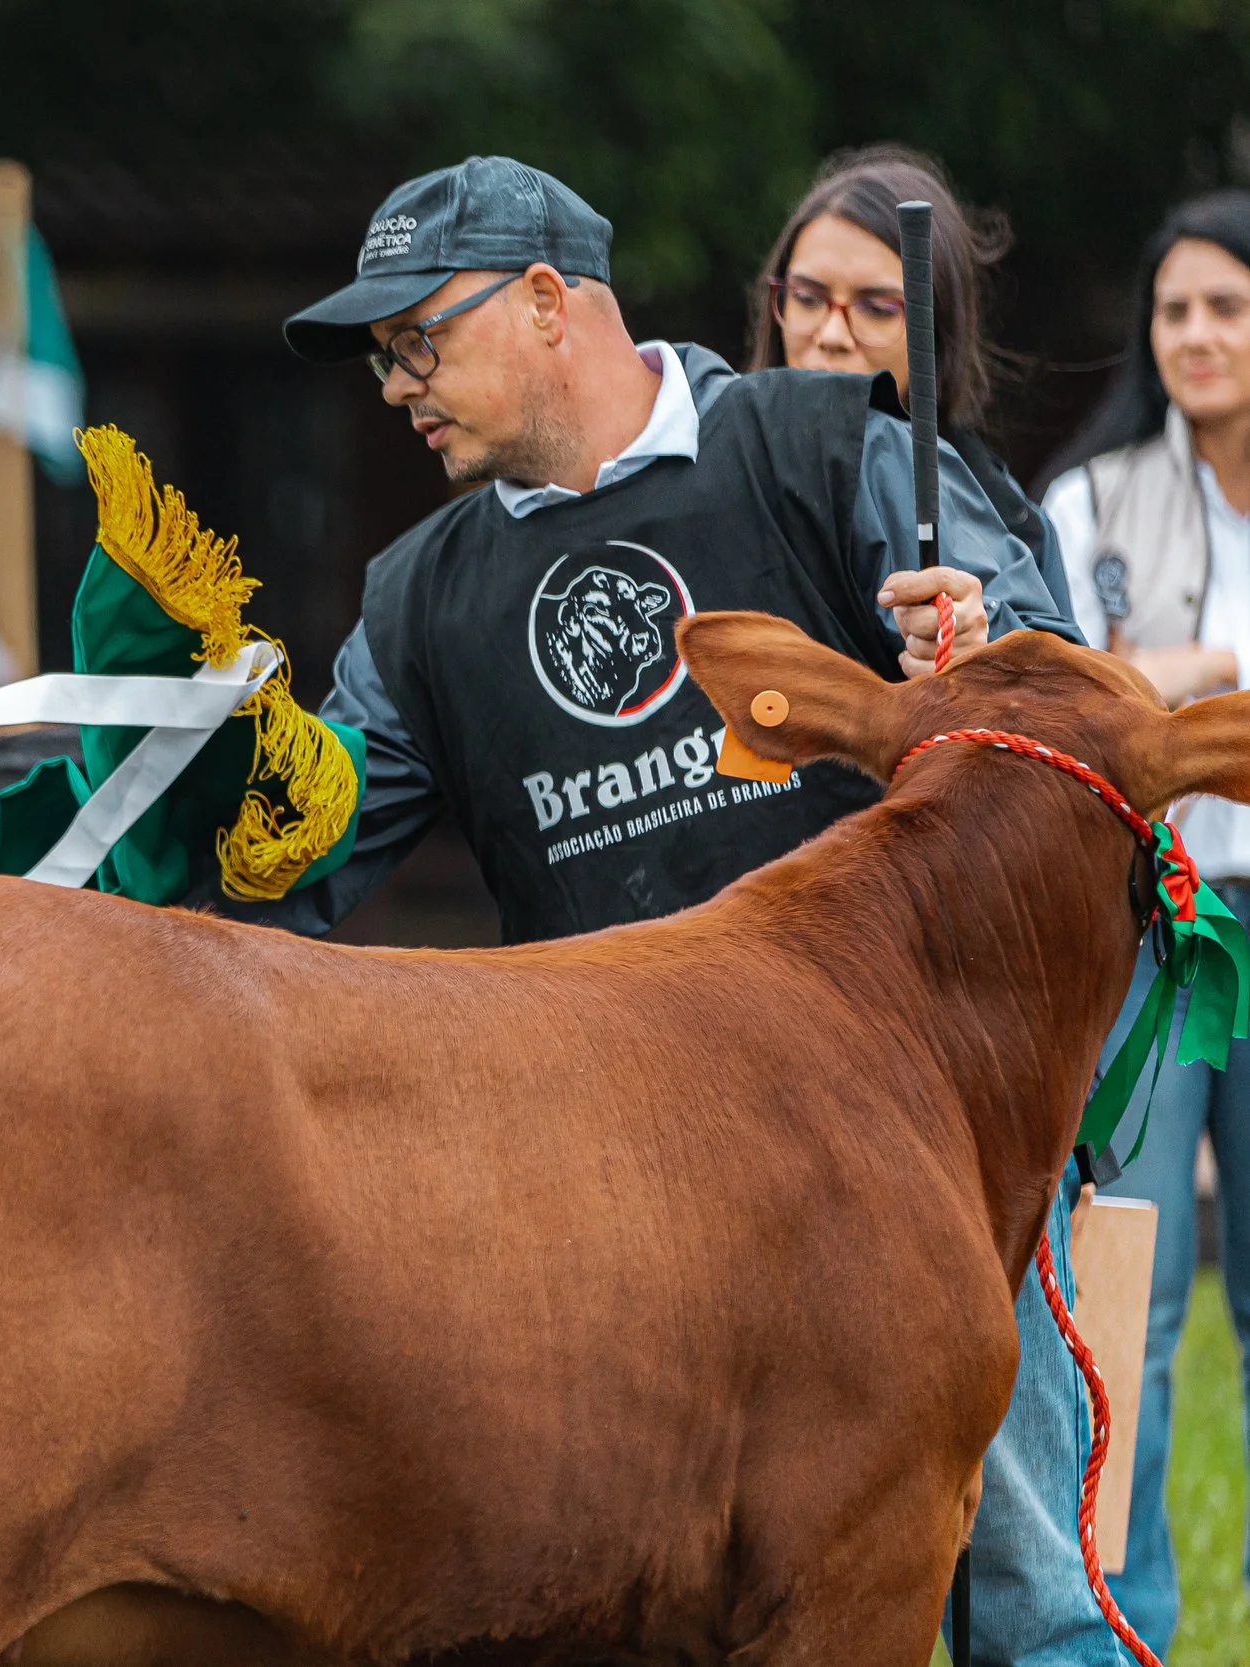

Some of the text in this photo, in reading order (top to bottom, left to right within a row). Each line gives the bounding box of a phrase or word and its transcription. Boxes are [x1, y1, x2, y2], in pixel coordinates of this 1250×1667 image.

[365, 232, 412, 252] ENÉTICA
[368, 214, 417, 236] OLUÇÃO
[522, 726, 727, 831] Brang
[547, 824, 623, 865] ASSOCIAÇÃO
[626, 796, 703, 838] BRASILEIRA
[707, 789, 728, 810] DE
